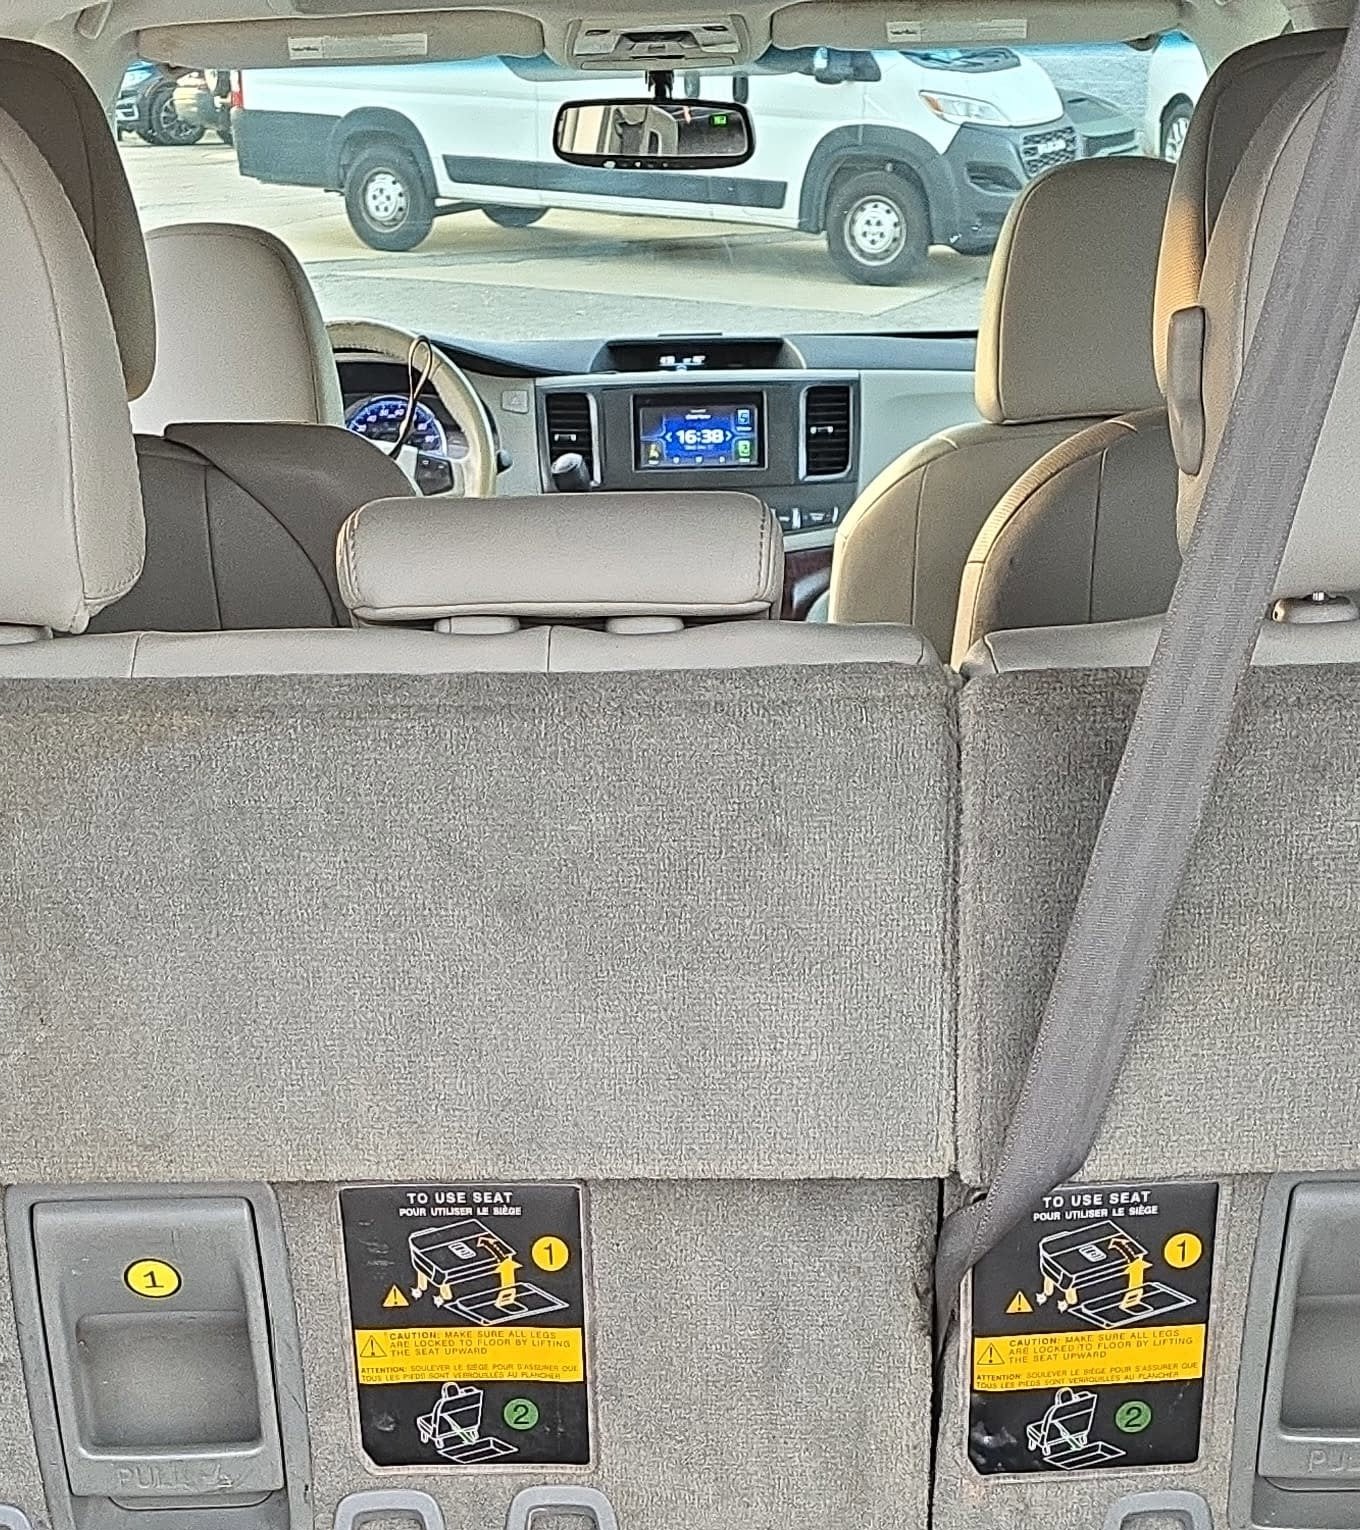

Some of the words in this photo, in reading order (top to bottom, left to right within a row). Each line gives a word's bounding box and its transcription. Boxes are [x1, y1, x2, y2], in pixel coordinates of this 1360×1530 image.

[675, 429, 725, 444] 16:38
[406, 1193, 428, 1204] TO
[435, 1192, 466, 1204] USE
[473, 1191, 513, 1203] SEAT
[1042, 1196, 1064, 1208] TO
[1071, 1194, 1102, 1206] USE
[1109, 1191, 1151, 1204] SEAT
[399, 1208, 426, 1217] POUR
[431, 1207, 472, 1216] UTILISER
[477, 1207, 489, 1216] LE
[1033, 1212, 1060, 1221] POUR
[1065, 1209, 1108, 1220] UTILISER
[1112, 1207, 1124, 1217] LE
[544, 1243, 553, 1265] 1
[1177, 1241, 1186, 1261] 1
[144, 1270, 164, 1288] 1
[444, 1331, 472, 1339] MAKE
[478, 1331, 503, 1339] SURE
[508, 1331, 526, 1339] ALL
[530, 1331, 557, 1339] LEGS
[1099, 1333, 1125, 1342] SURE
[1130, 1331, 1149, 1340] ALL
[1153, 1330, 1180, 1339] LEGS
[390, 1340, 409, 1348] ARE
[414, 1339, 454, 1348] LOCKED
[460, 1339, 473, 1347] TO
[477, 1338, 510, 1347] FLOOR
[516, 1338, 528, 1346] BY
[532, 1339, 571, 1348] LIFTING
[1009, 1346, 1029, 1355] ARE
[1033, 1343, 1075, 1353] LOCKED
[1080, 1342, 1093, 1351] TO
[1098, 1339, 1131, 1349] FLOOR
[1137, 1338, 1148, 1347] BY
[1153, 1337, 1193, 1346] LIFTING
[391, 1349, 410, 1357] THE
[415, 1348, 440, 1356] SEAT
[445, 1347, 488, 1355] UPWARD
[1009, 1355, 1029, 1364] THE
[1034, 1353, 1059, 1362] SEAT
[1064, 1350, 1107, 1360] UPWARD
[513, 1404, 529, 1425] 2
[1125, 1406, 1142, 1428] 2
